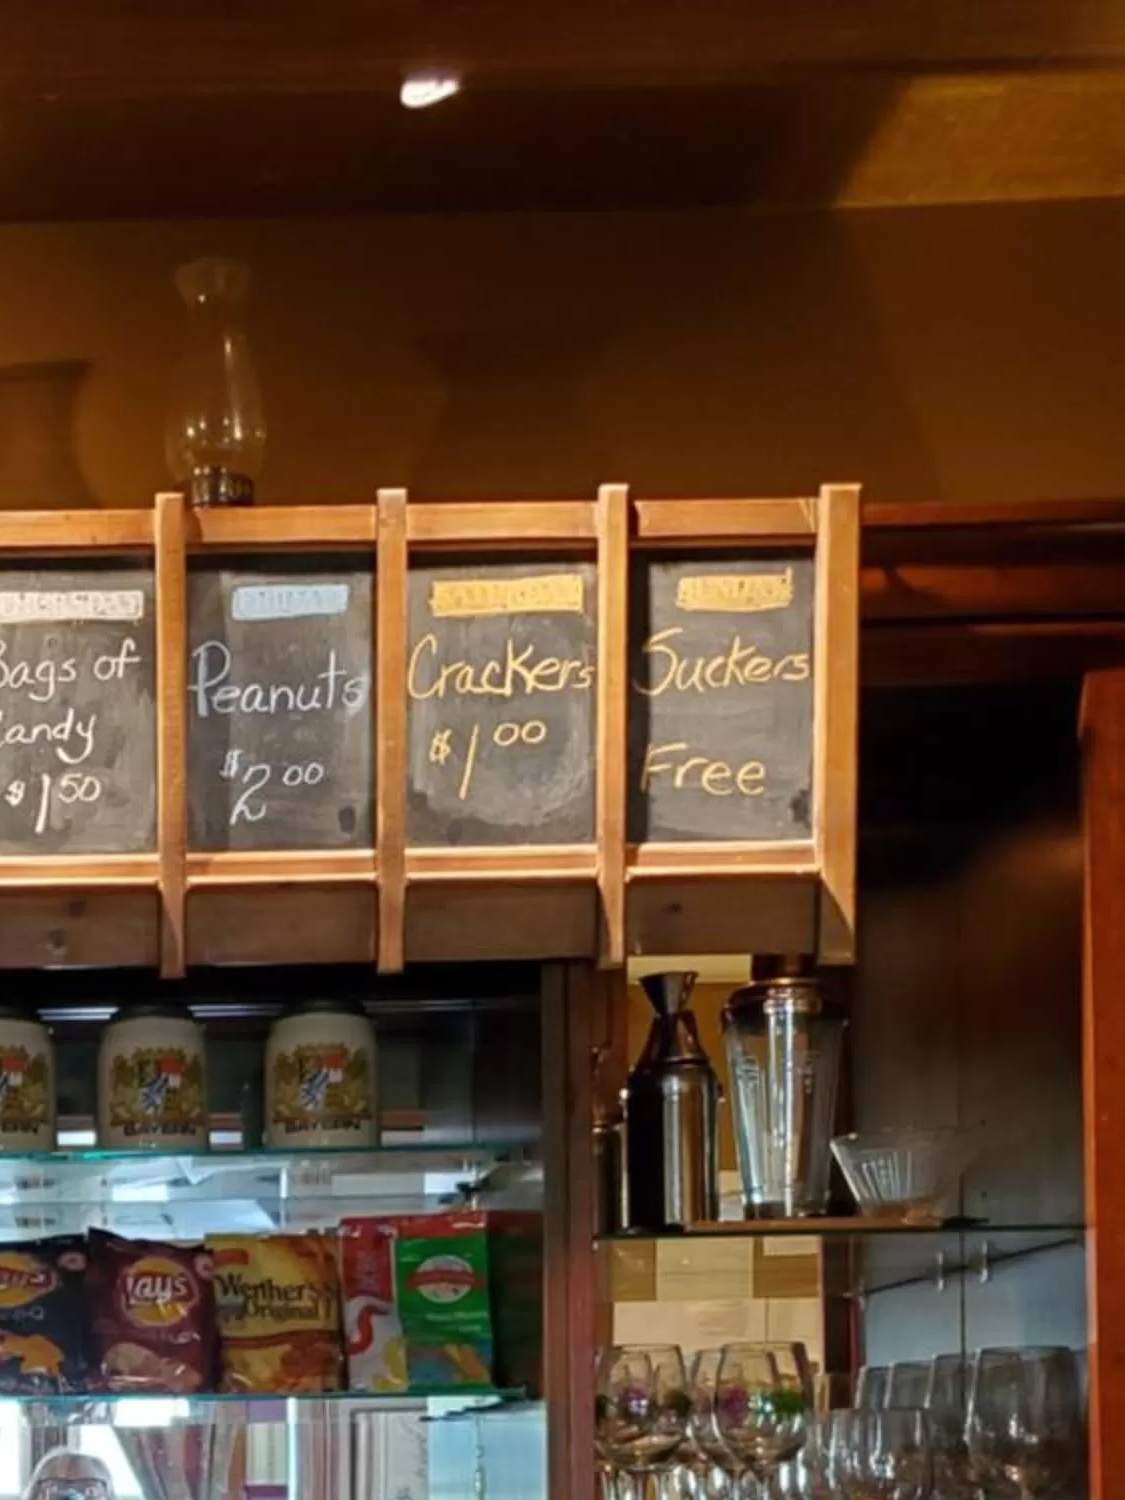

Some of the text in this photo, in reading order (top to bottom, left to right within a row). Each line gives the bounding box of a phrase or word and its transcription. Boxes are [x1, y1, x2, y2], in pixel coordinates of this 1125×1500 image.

[94, 639, 140, 681] of
[189, 639, 365, 718] Peanuts
[408, 635, 594, 701] Crackers
[634, 627, 810, 697] Suckers
[641, 742, 766, 795] Free
